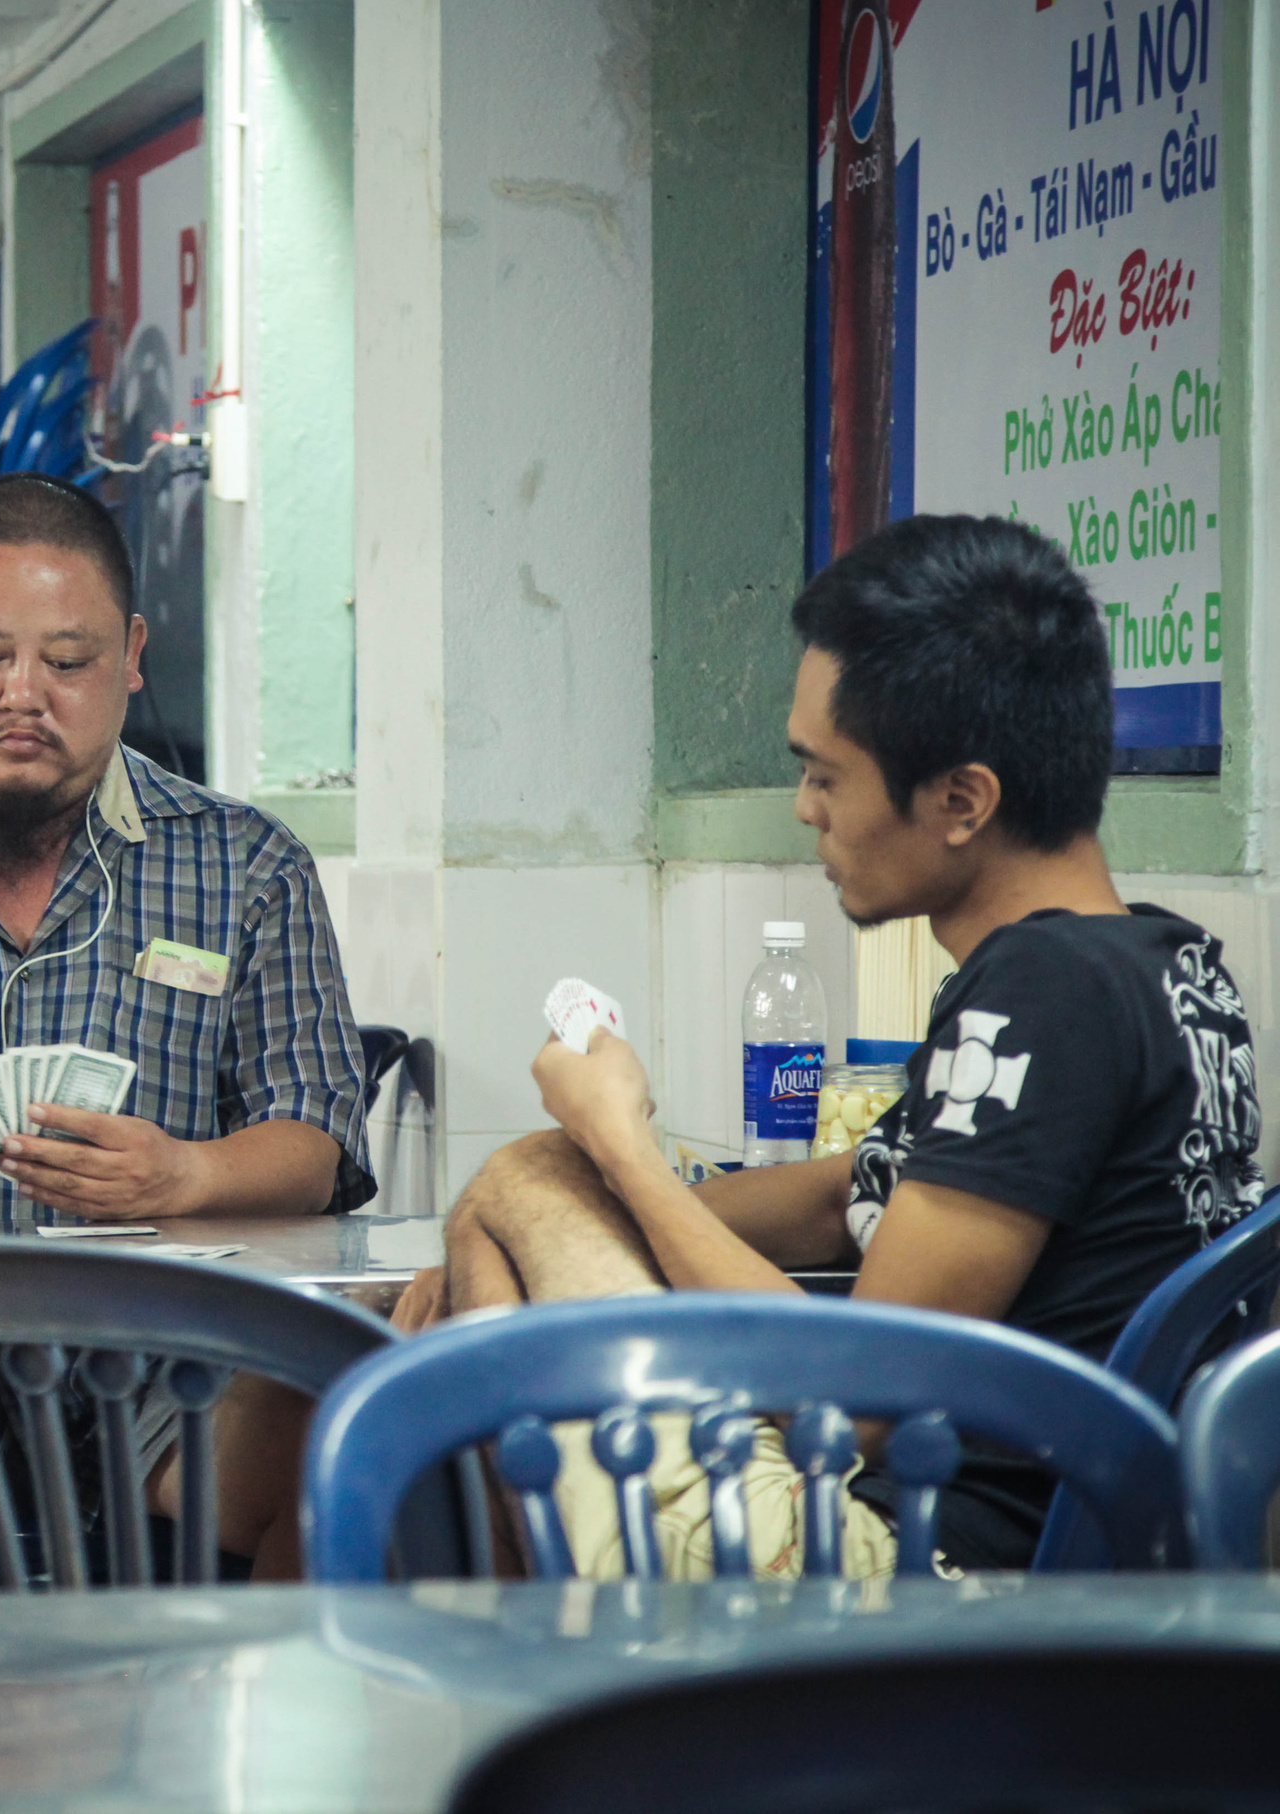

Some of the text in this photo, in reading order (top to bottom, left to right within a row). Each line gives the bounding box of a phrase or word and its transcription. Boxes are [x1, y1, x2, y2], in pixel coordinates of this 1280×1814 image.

[1069, 0, 1122, 131] HÀ
[925, 206, 956, 278] Bò
[976, 187, 1008, 262] Gà
[1030, 166, 1069, 244] Tái
[1075, 158, 1134, 238] Nạm
[1160, 108, 1218, 204] Gầu
[1050, 248, 1196, 370] Đặc Biệt:
[1004, 361, 1220, 476] Phở Xào Áp Ch
[1067, 496, 1120, 567] Xào
[1128, 483, 1197, 561] Giòn
[1104, 582, 1193, 670] Thuốc
[769, 1065, 822, 1098] AQUAFI
